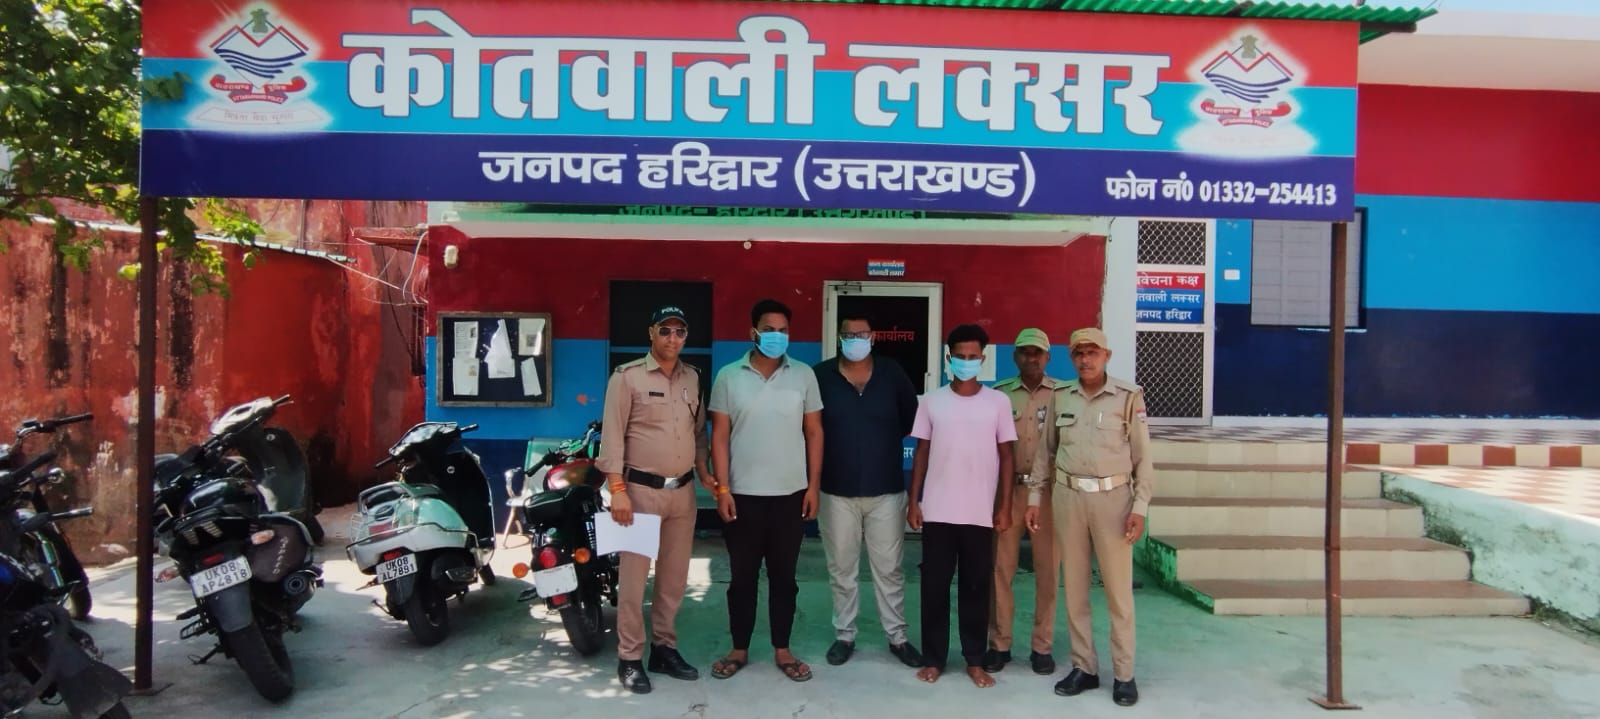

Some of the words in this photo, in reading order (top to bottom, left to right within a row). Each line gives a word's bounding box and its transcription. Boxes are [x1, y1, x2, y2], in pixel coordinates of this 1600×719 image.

[341, 8, 826, 126] कोतवाली
[848, 43, 1171, 136] लक्सर
[478, 152, 627, 184] जनपद
[636, 141, 783, 191] हरिद्वार
[794, 144, 1036, 207] (उत्तराखण्ड)
[1106, 169, 1158, 200] फोन
[1200, 180, 1337, 206] 01332-254413
[1137, 273, 1173, 286] वेचना
[1176, 275, 1200, 287] कक्ष
[1136, 290, 1168, 303] तवाली
[204, 561, 237, 581] UK08
[385, 556, 409, 571] UK08
[202, 568, 248, 594] AP4818
